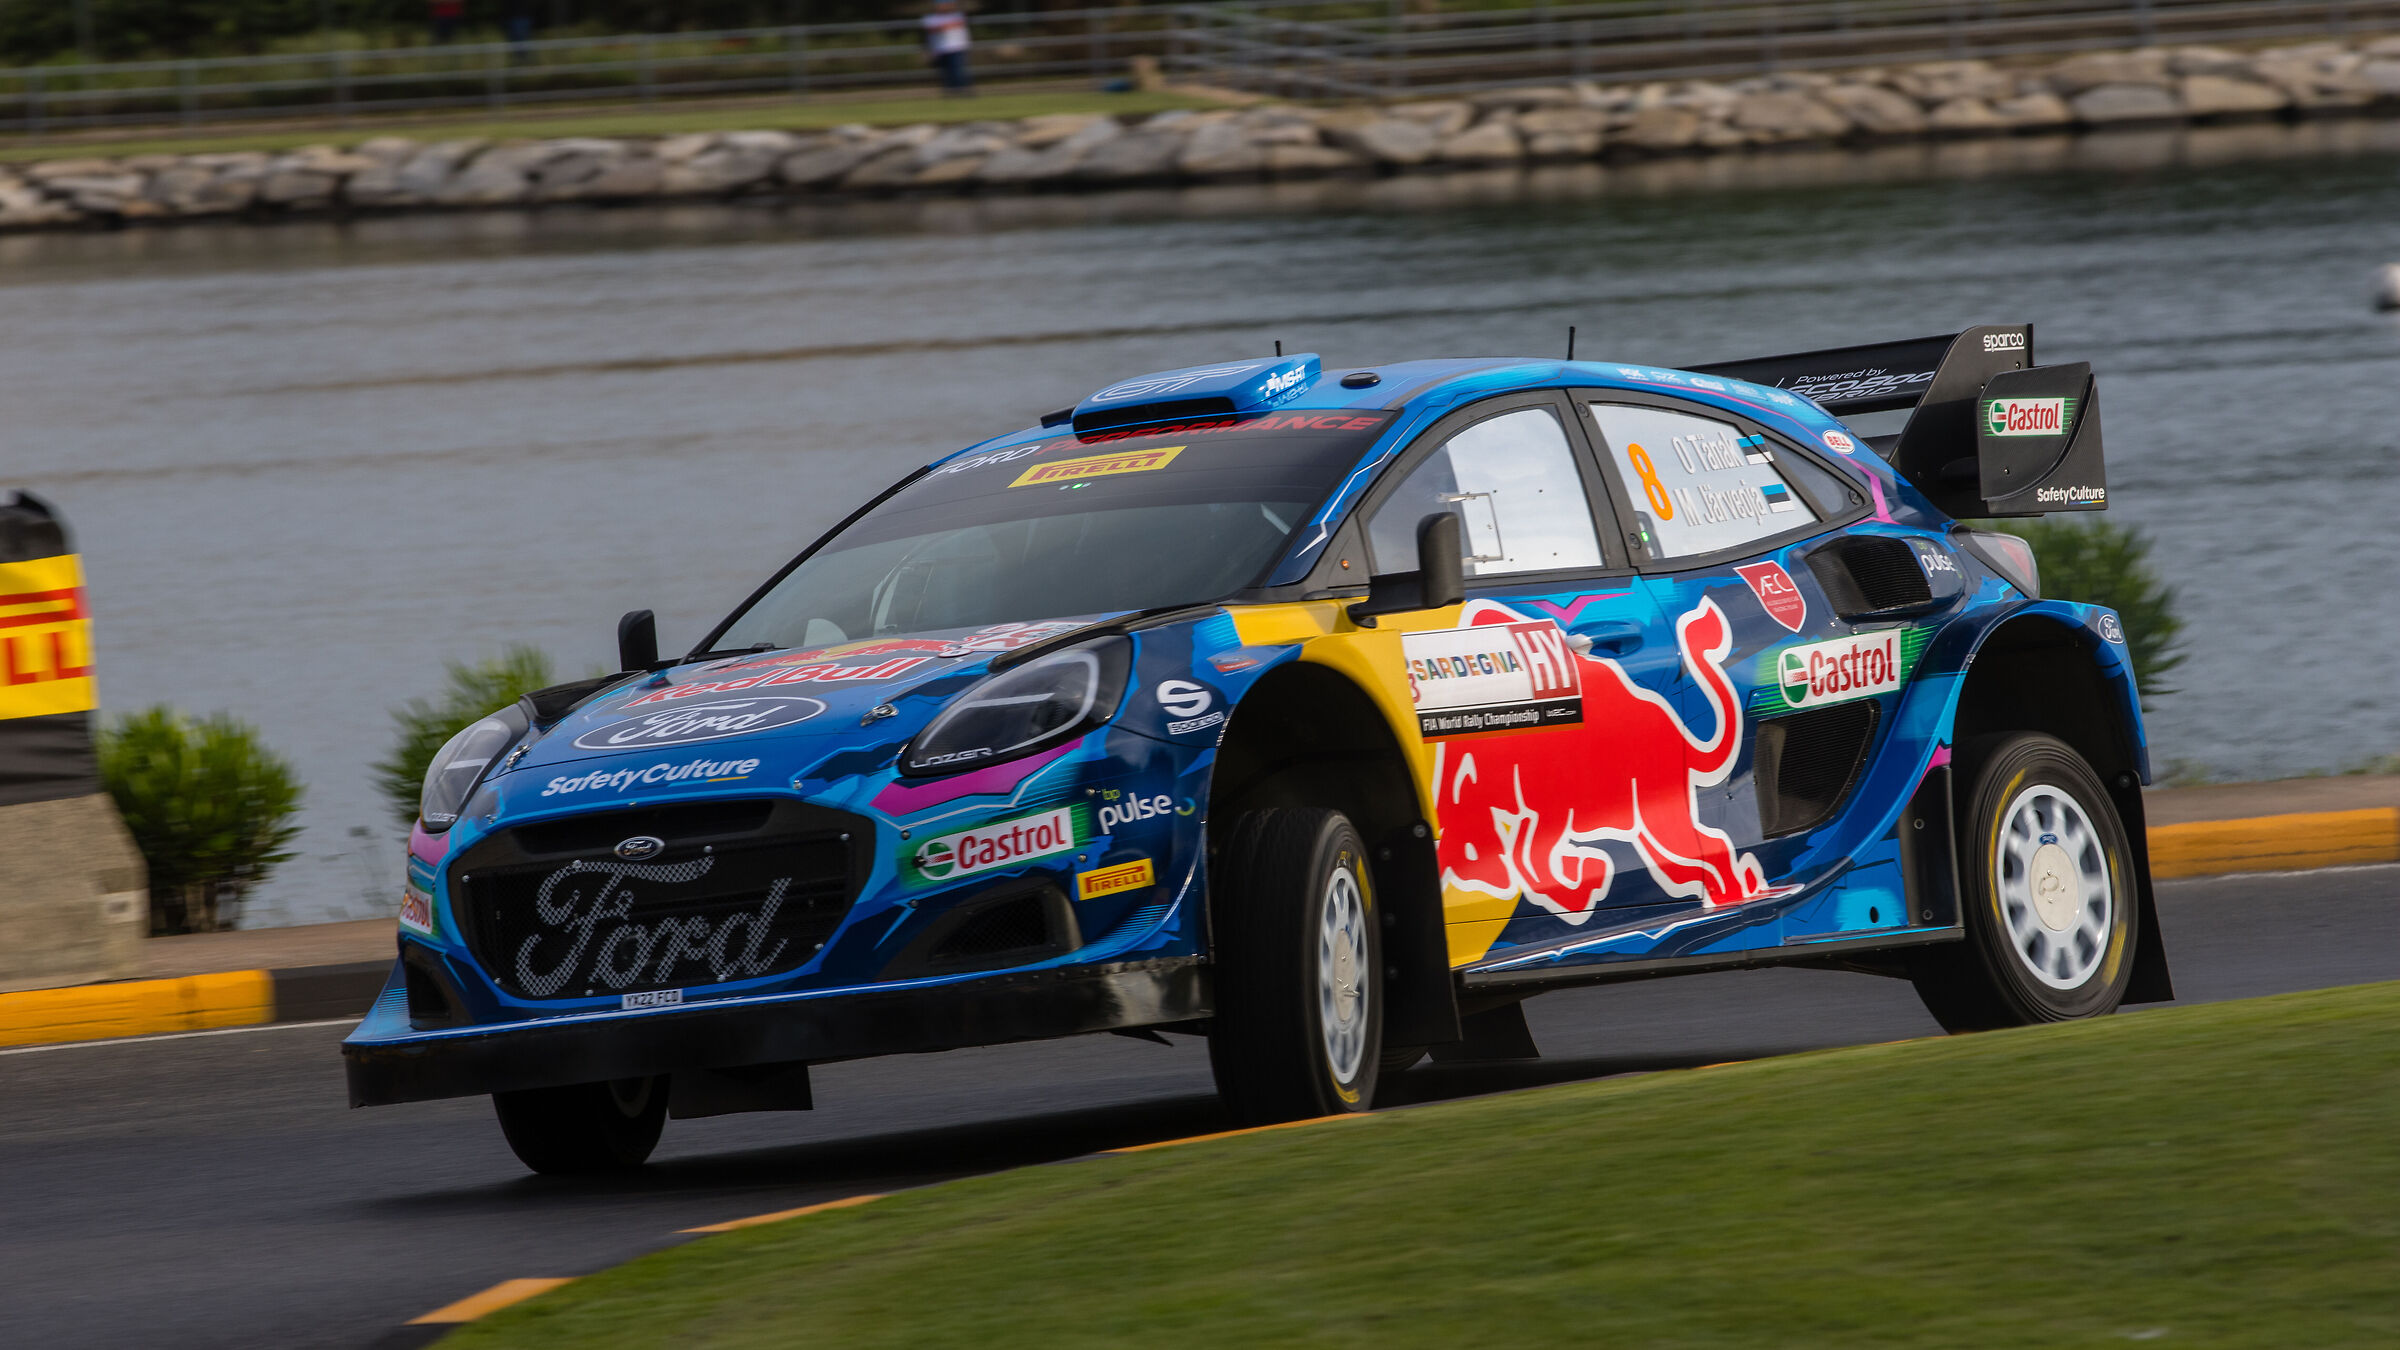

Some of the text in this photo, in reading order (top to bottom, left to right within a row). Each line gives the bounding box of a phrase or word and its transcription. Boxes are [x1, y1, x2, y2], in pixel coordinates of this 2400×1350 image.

[1983, 332, 2025, 351] sparco
[1795, 367, 1887, 385] Powered by
[2008, 403, 2059, 431] Castrol
[926, 415, 1384, 481] FORD PERFORMANCE
[1826, 435, 1851, 447] BELL
[1027, 452, 1167, 482] PIRELLI
[1627, 431, 1745, 521] 8 O Tänak
[1673, 479, 1768, 527] M Järveoja
[2037, 485, 2105, 505] SafetyCulture
[1921, 547, 1956, 578] pulse
[2103, 617, 2122, 639] Ford
[1411, 650, 1524, 681] SARDEGNA
[1515, 628, 1571, 692] HY
[1810, 637, 1895, 697] Castrol
[621, 656, 934, 709] Red Bull
[607, 702, 788, 744] Ford
[1422, 708, 1539, 732] FIA World Rally Championship
[909, 747, 993, 769] LAZER
[541, 757, 761, 797] SafetyCulture
[1101, 788, 1121, 801] bp
[1098, 792, 1173, 835] pulse
[957, 815, 1068, 870] Castrol
[1085, 865, 1147, 895] PIRELLI
[515, 856, 792, 997] Ford
